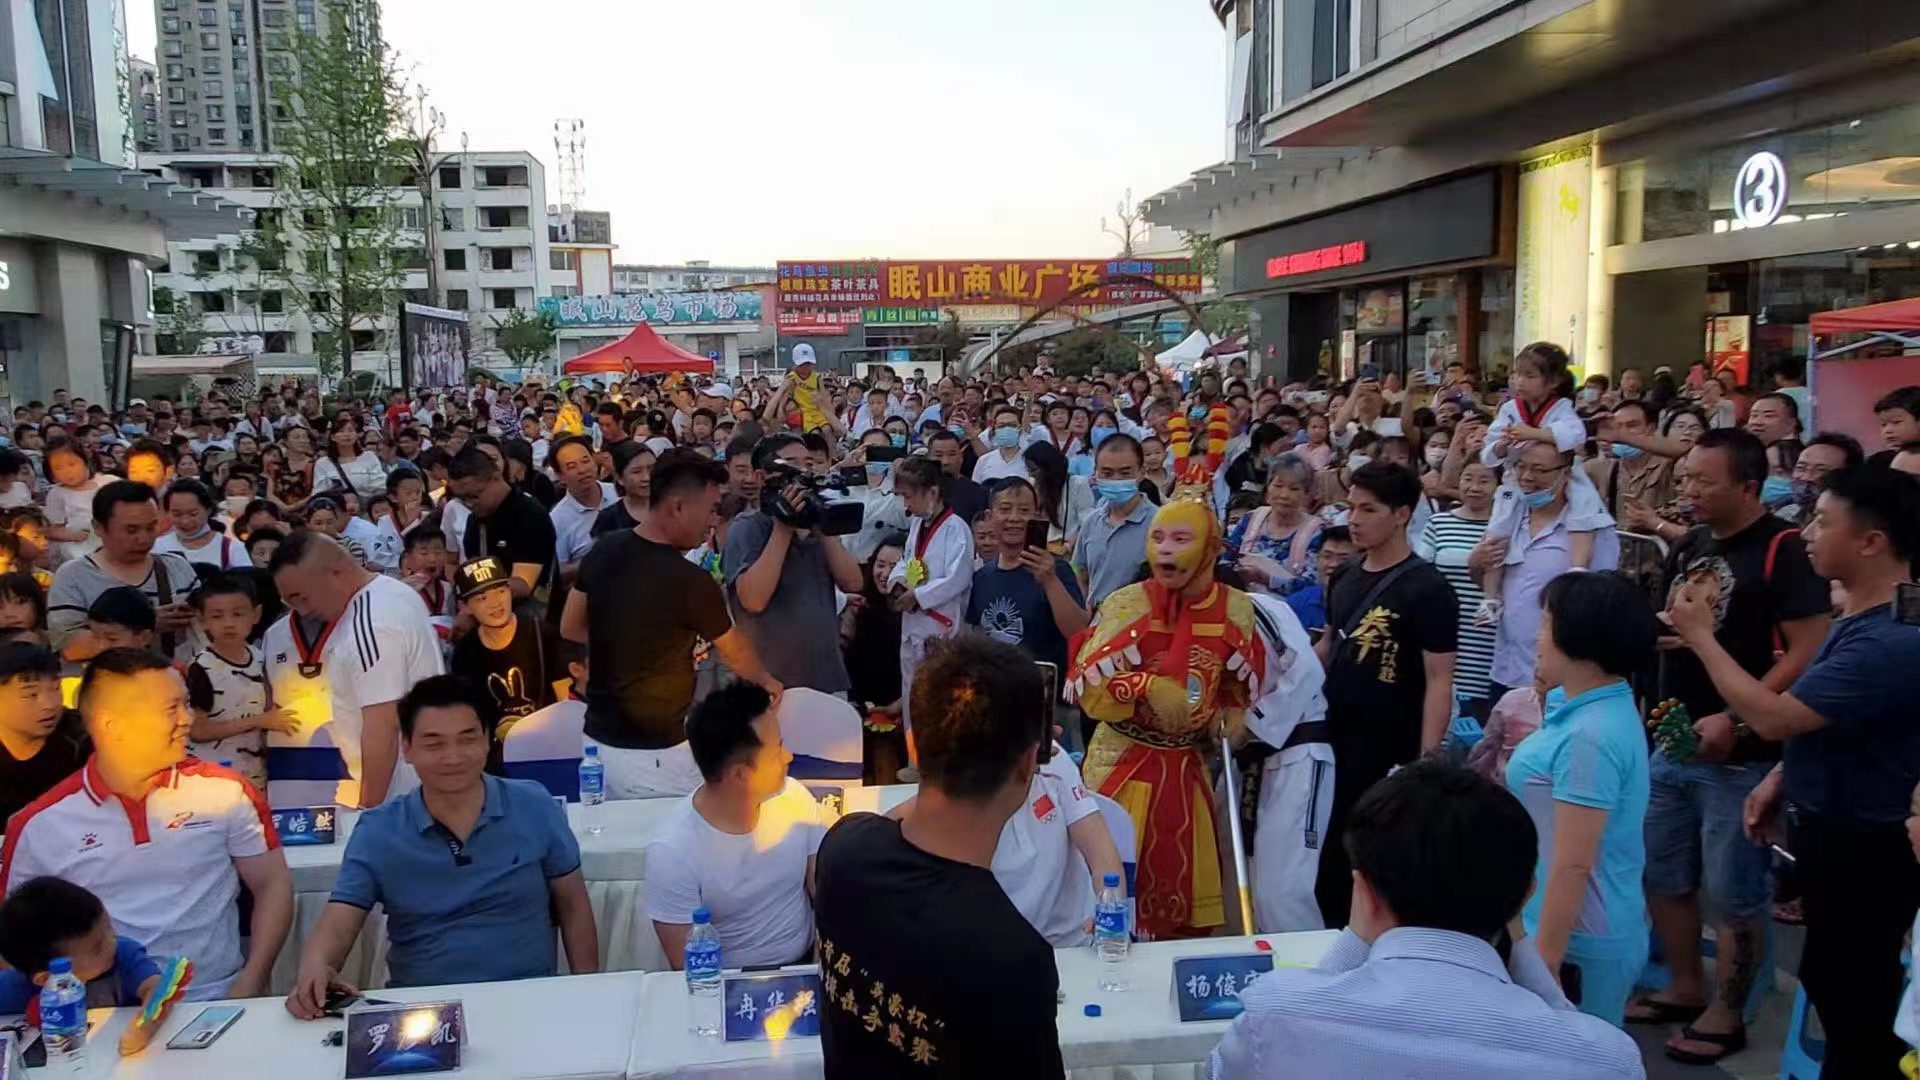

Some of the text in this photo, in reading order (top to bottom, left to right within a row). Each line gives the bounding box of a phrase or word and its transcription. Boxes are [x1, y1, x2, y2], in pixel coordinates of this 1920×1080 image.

[1744, 155, 1778, 225] 3
[888, 263, 1100, 299] 眠山商业广场
[559, 293, 739, 322] 眠山花鸟市场
